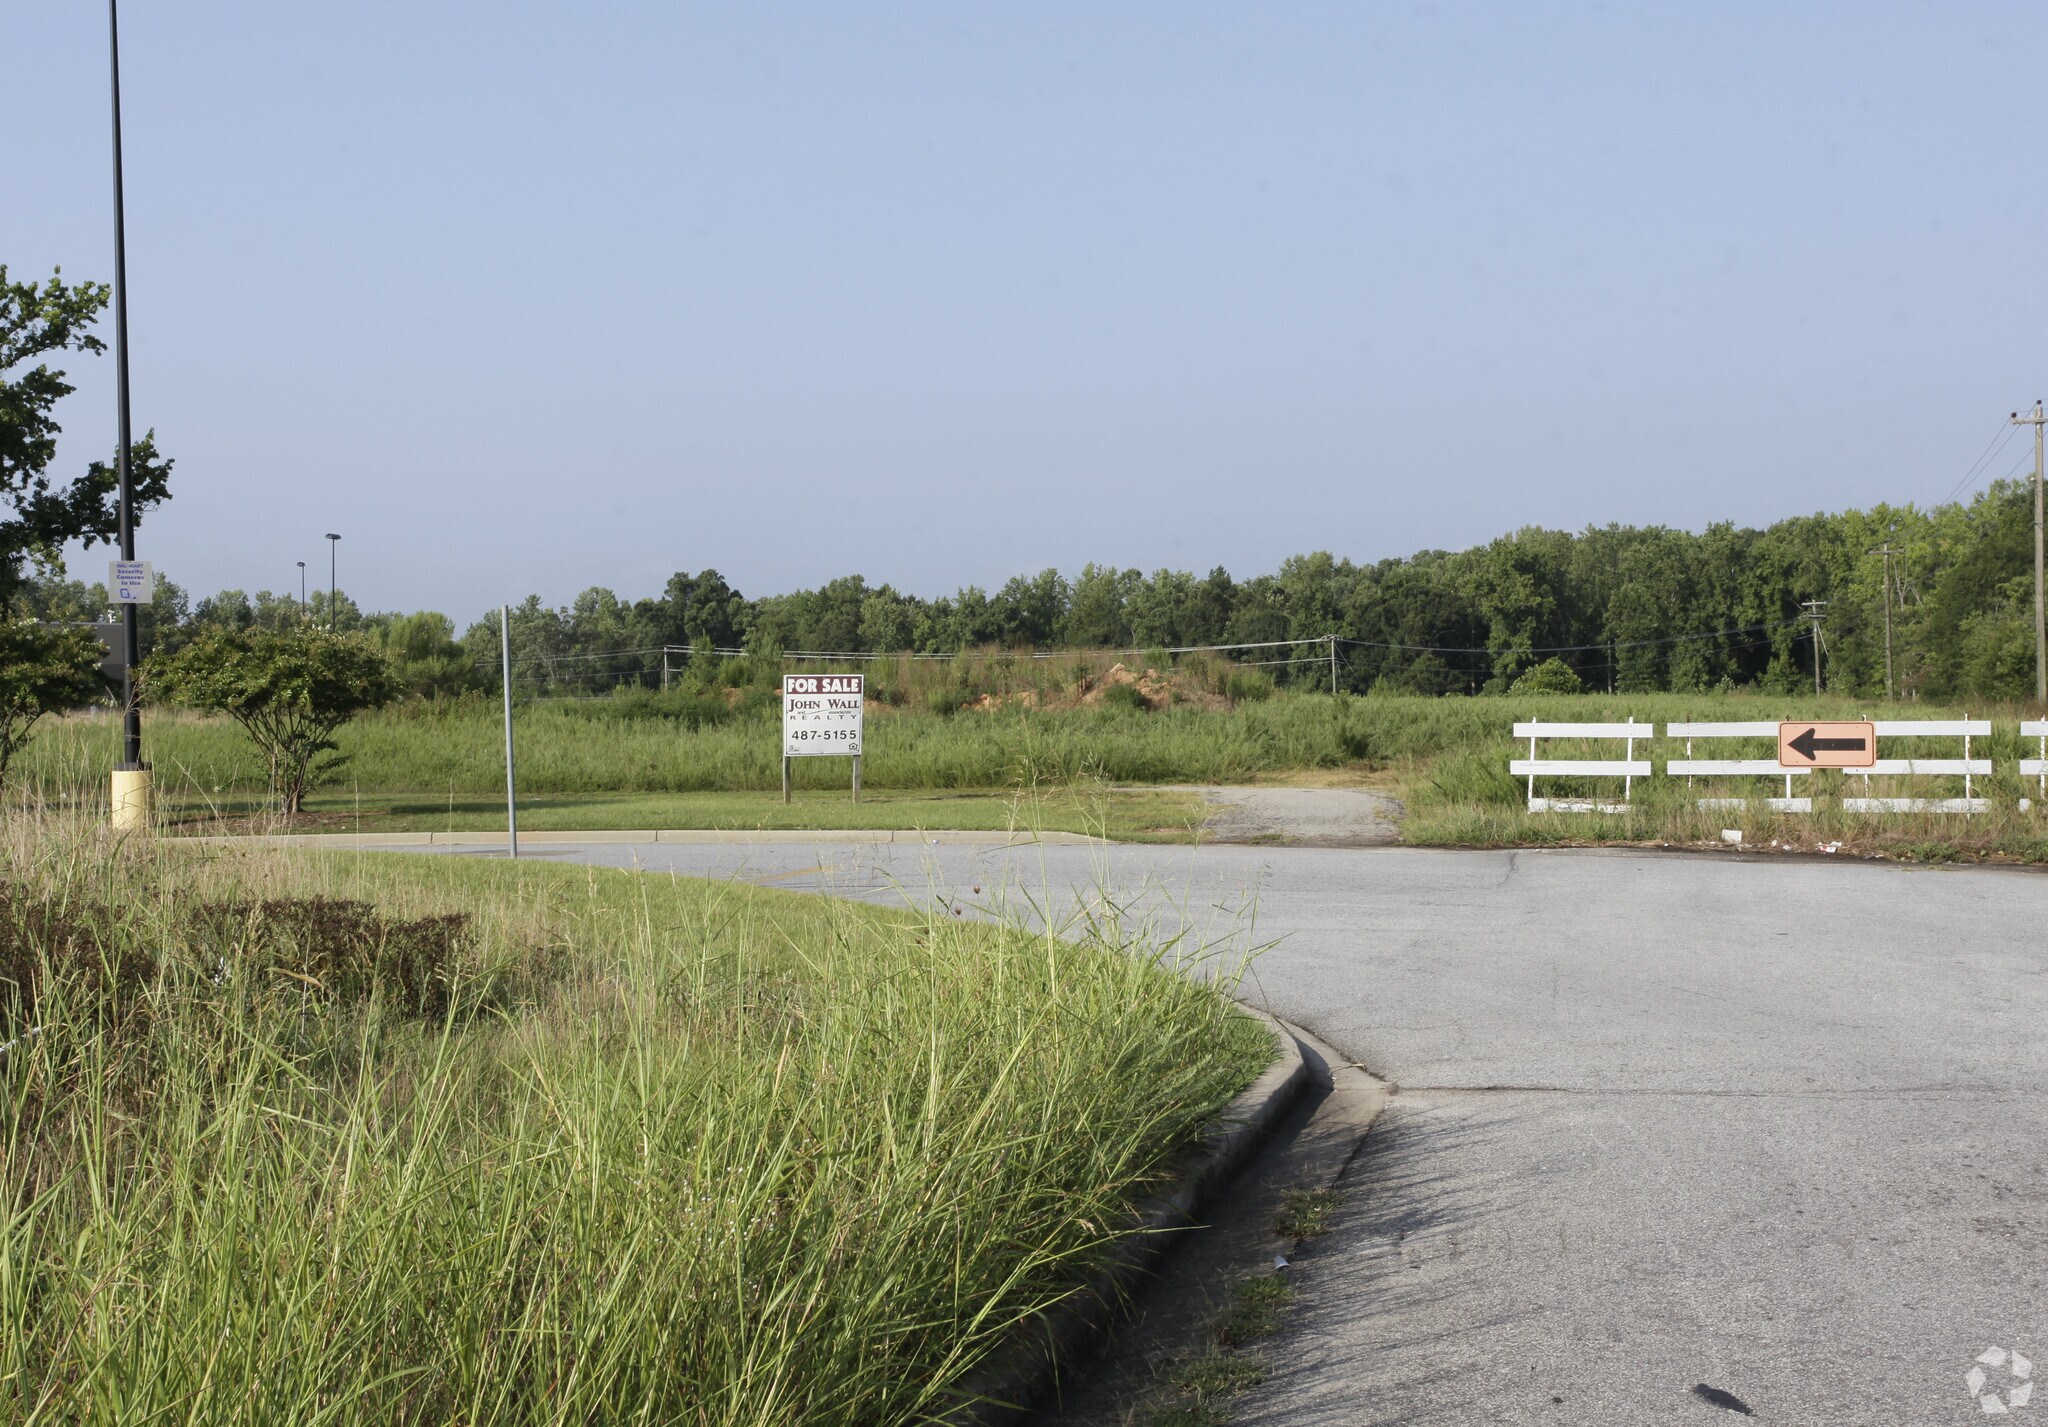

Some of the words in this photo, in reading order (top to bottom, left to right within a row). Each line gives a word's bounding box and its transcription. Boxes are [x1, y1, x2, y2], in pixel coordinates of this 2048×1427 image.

[787, 679, 817, 692] FOR
[822, 678, 859, 692] SALE
[788, 699, 820, 712] JOHN
[827, 699, 859, 709] WALL
[792, 730, 856, 740] 487-5155
